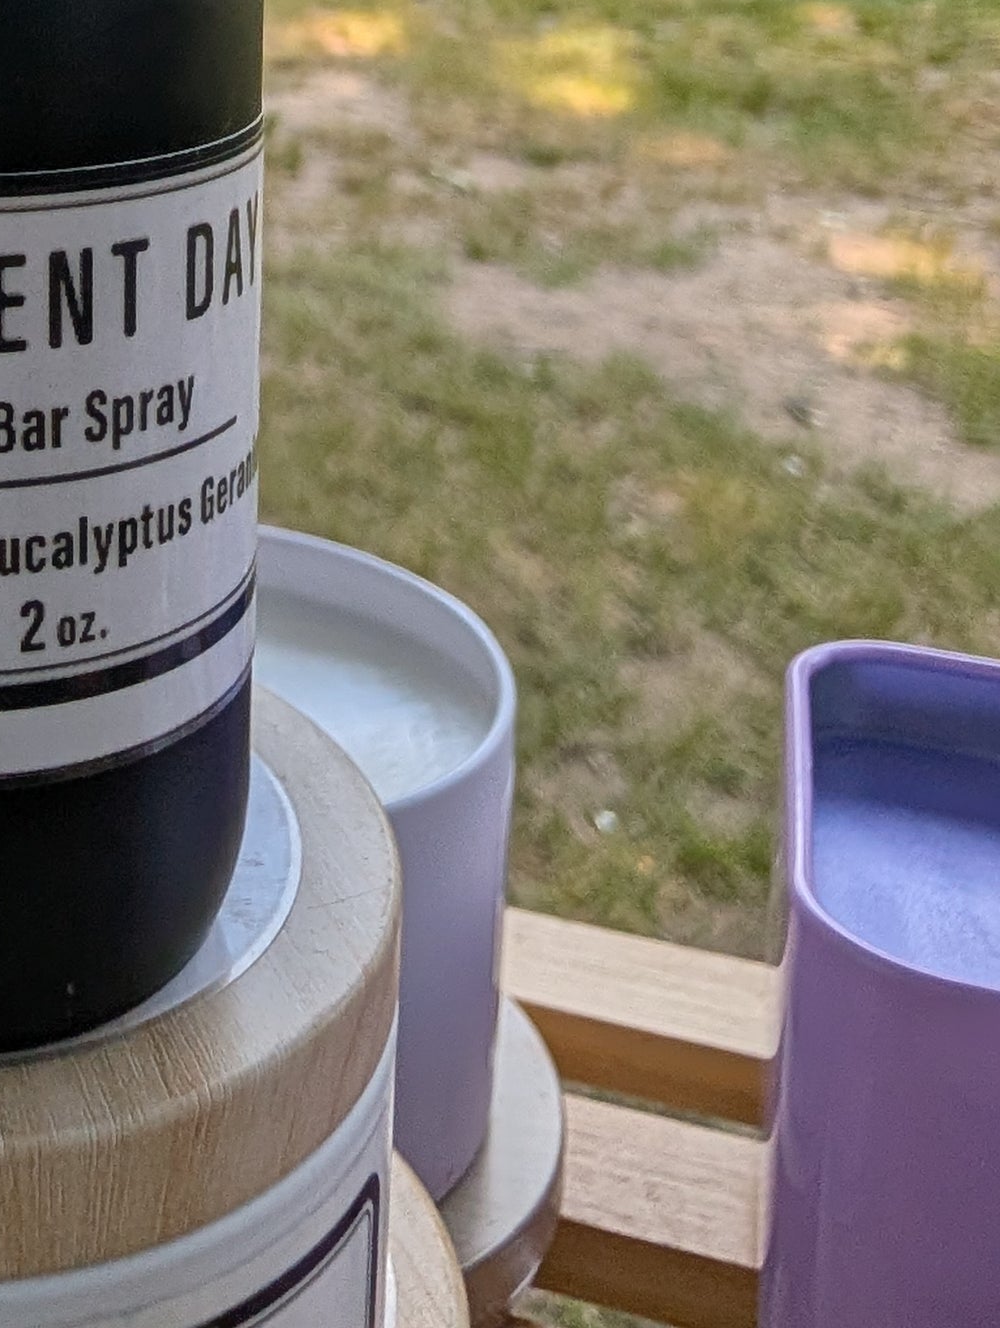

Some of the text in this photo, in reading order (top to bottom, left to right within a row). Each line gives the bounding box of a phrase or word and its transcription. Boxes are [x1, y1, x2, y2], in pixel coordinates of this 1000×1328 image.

[185, 190, 258, 321] DAY
[84, 375, 194, 449] Spray
[201, 437, 257, 524] Geran
[18, 600, 108, 653] 2 oz.
